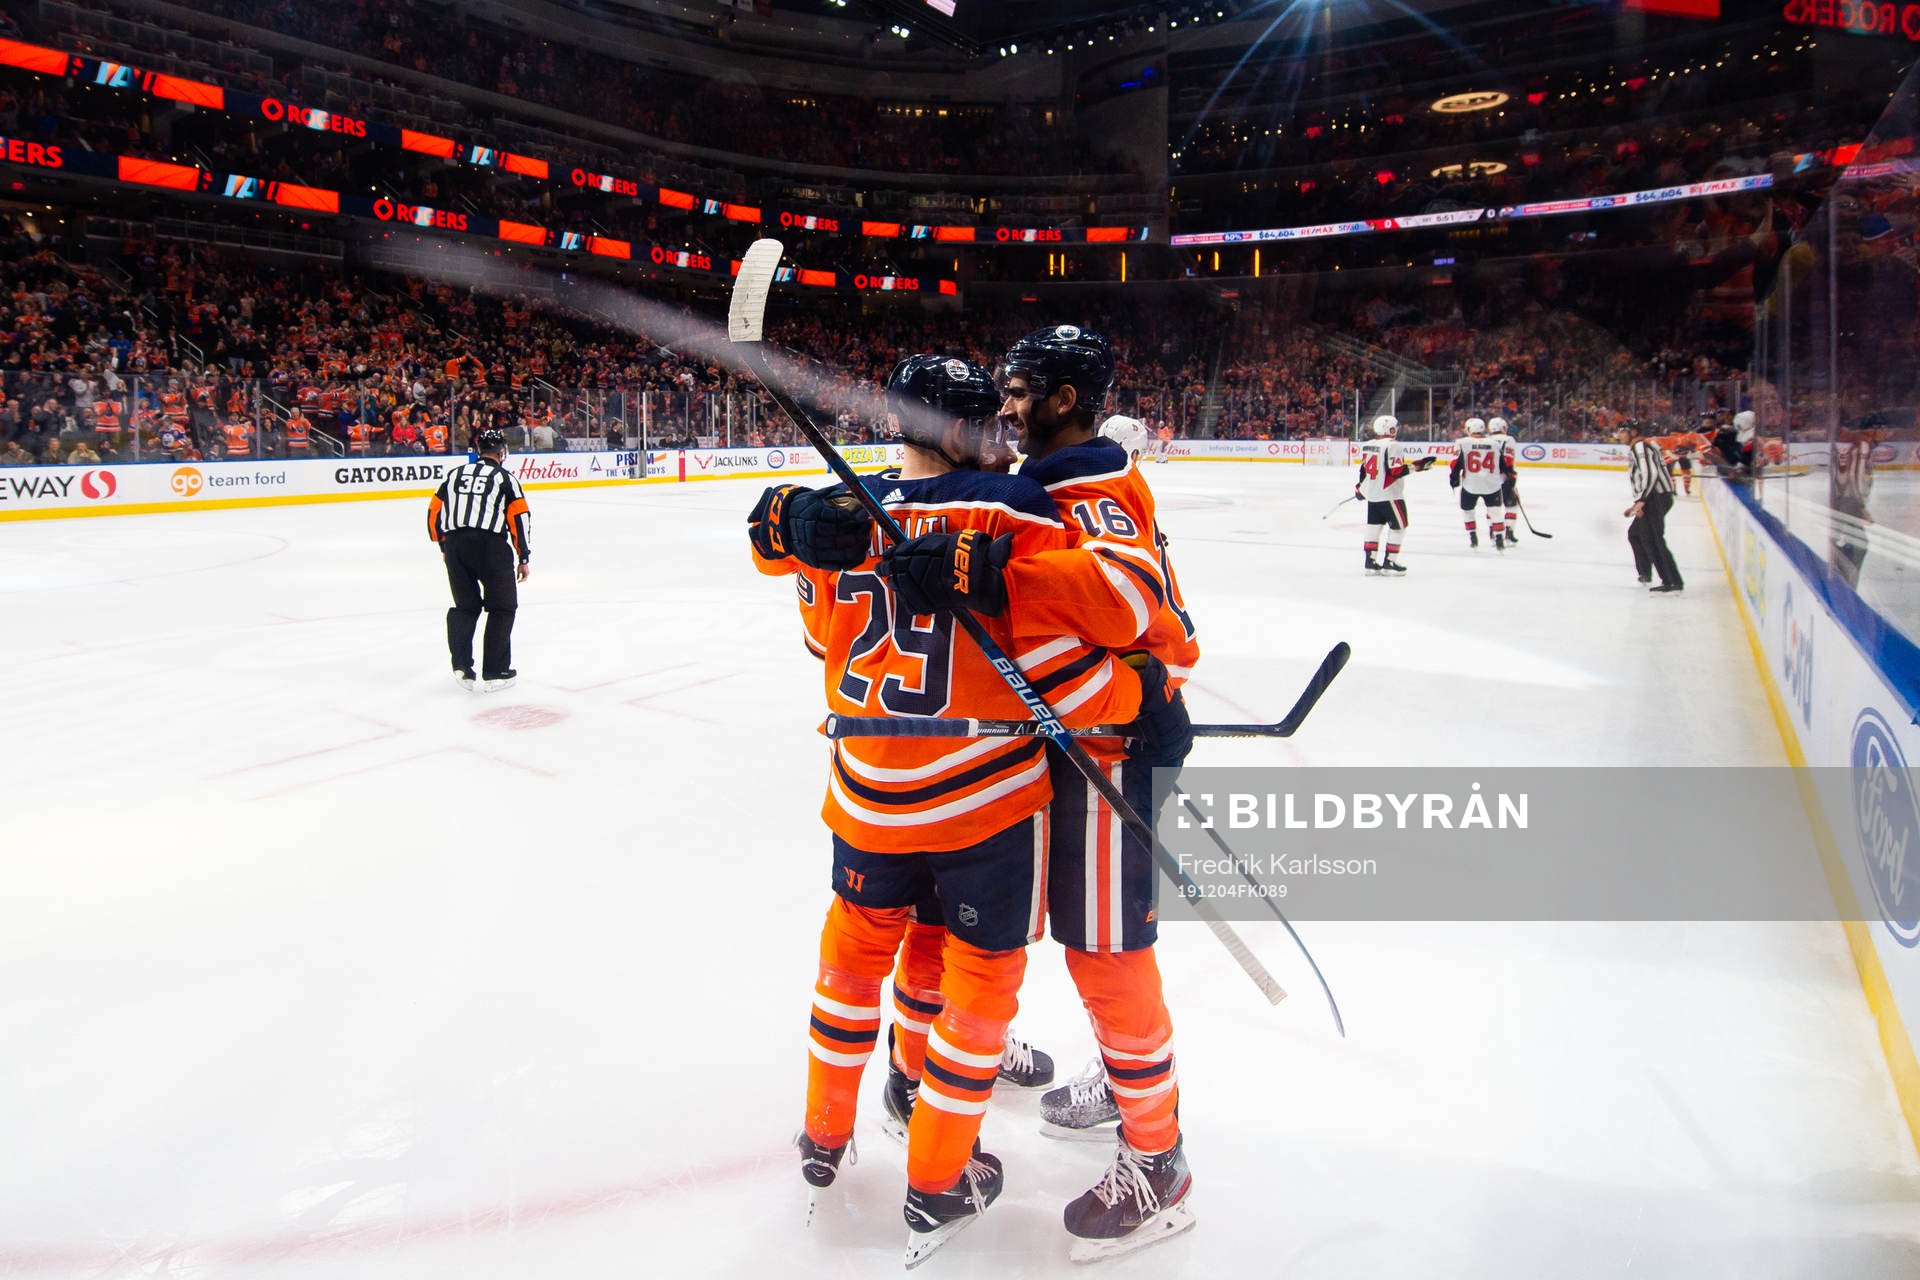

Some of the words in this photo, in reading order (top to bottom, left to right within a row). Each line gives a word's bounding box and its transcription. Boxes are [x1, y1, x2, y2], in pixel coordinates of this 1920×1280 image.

[287, 104, 367, 138] ROGERS
[587, 173, 638, 197] ROGERS
[397, 203, 468, 231] ROGERS
[794, 214, 839, 232] ROGERS
[1011, 228, 1062, 242] ROGERS
[1300, 226, 1334, 235] RE/MAX
[665, 251, 711, 270] ROGERS
[869, 275, 919, 290] ROGERS
[713, 456, 734, 468] JACK
[789, 453, 800, 465] 80
[843, 447, 873, 463] PIZZA
[875, 447, 887, 462] 73
[1467, 451, 1495, 473] 64
[1552, 448, 1567, 458] 80
[335, 464, 444, 484] GATORADE
[518, 457, 578, 480] Hortons
[172, 474, 202, 497] go
[208, 474, 250, 487] team
[255, 472, 286, 485] ford
[458, 475, 489, 494] 36
[1072, 497, 1139, 539] 16
[953, 528, 974, 594] UER
[837, 570, 956, 718] 29
[1860, 735, 1909, 906] Ford
